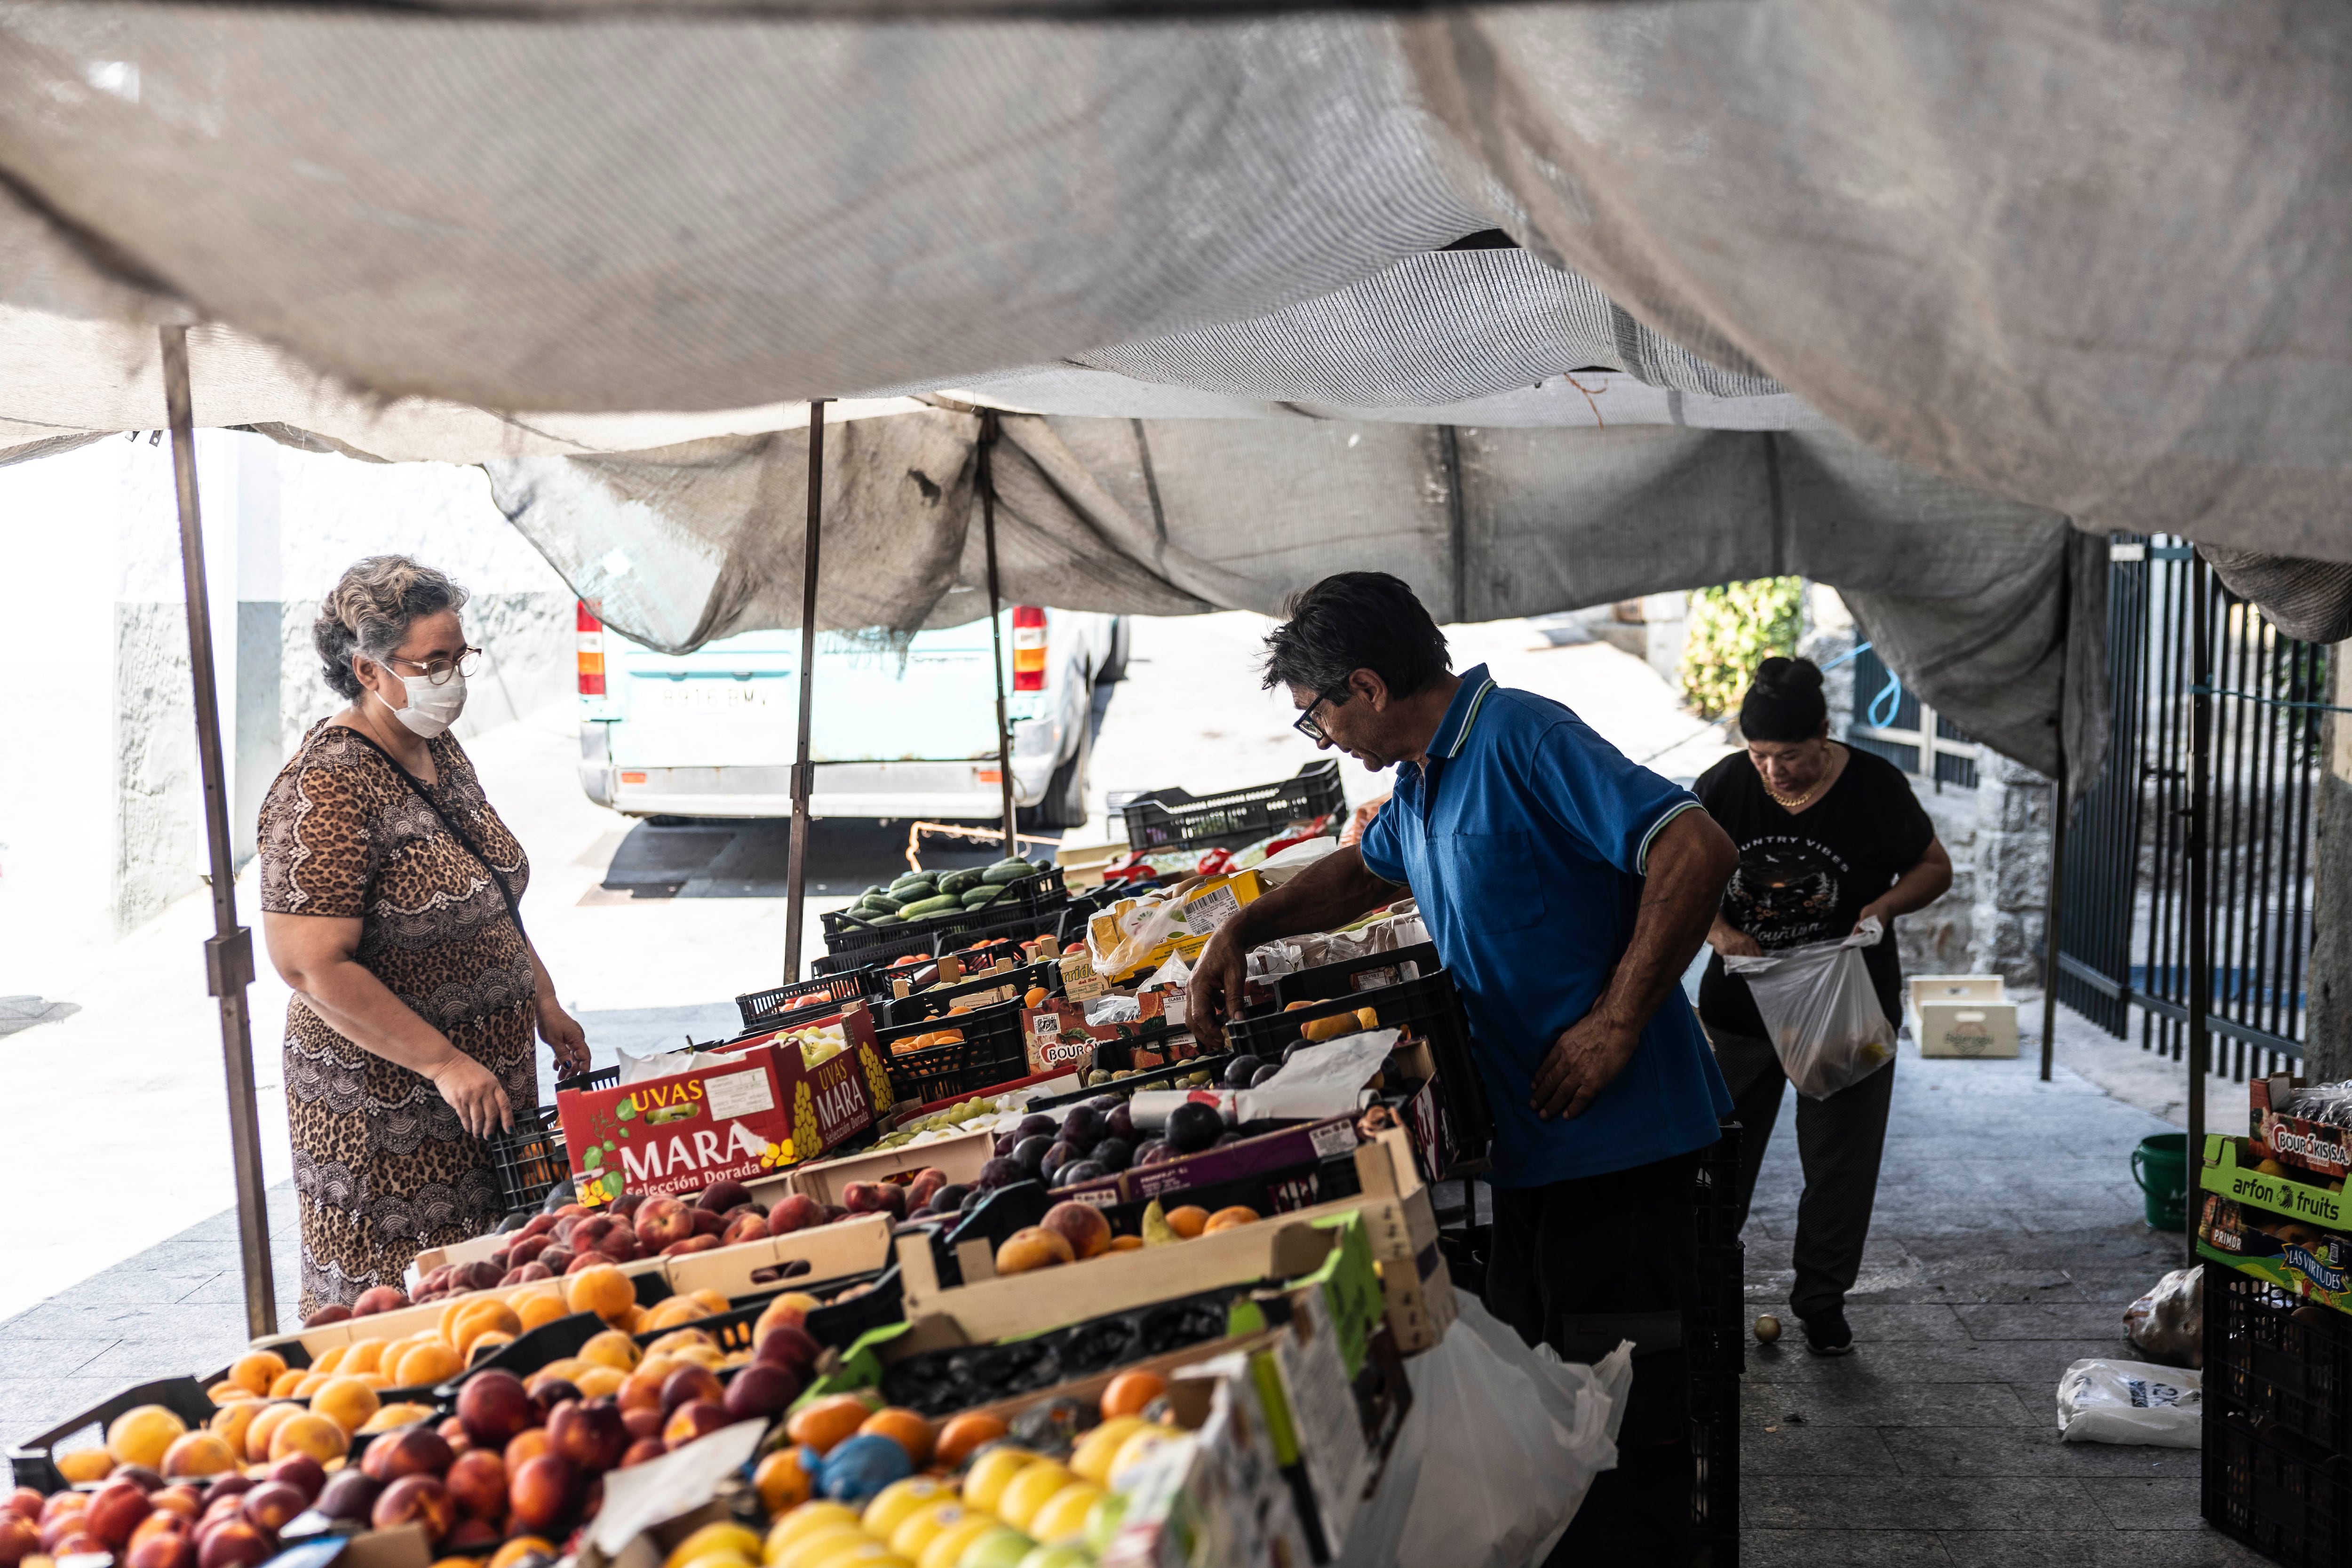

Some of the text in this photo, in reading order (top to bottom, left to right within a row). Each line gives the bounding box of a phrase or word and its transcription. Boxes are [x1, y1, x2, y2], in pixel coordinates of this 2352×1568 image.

[1739, 836, 1849, 872] UNTRY VIBES
[818, 1059, 847, 1090] UVAS
[630, 1079, 703, 1112] UVAS
[816, 1075, 865, 1130] MARA
[825, 1109, 869, 1145] Selección Dorada
[620, 1122, 757, 1184] MARA
[2331, 1146, 2349, 1164] S.A.
[626, 1161, 761, 1197] Selección Dorada
[2233, 1178, 2340, 1221] arfon fruits
[2213, 1229, 2241, 1250] PRIMOR
[2289, 1250, 2341, 1289] LAS VIRTUDES
